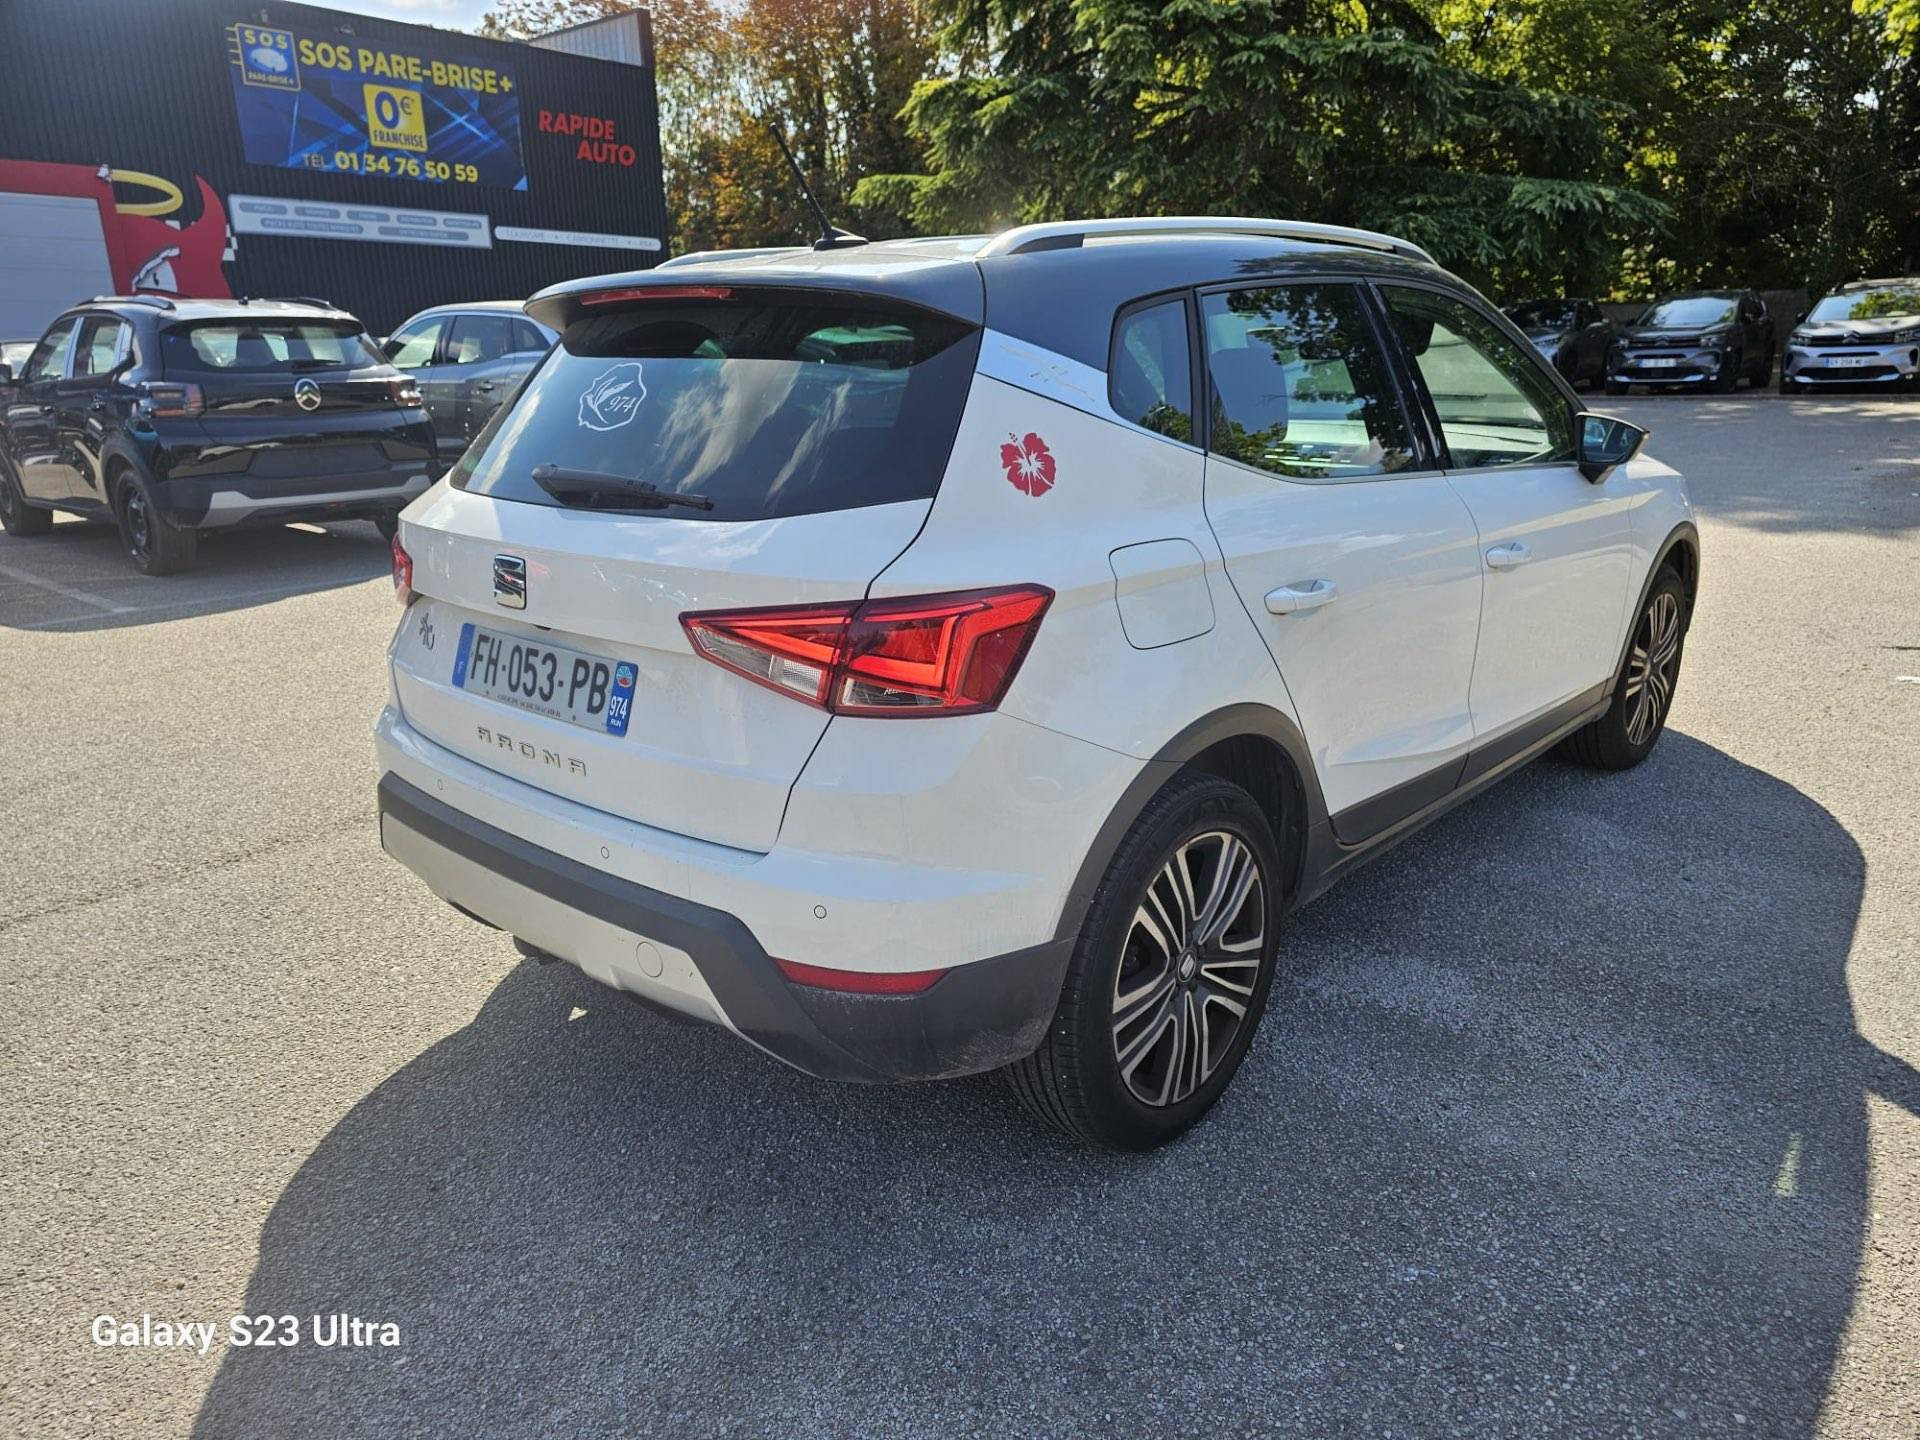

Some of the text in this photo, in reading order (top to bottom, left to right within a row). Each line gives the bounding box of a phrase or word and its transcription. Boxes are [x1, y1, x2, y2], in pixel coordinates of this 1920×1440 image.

[244, 29, 288, 49] SOS
[299, 39, 352, 71] SOS
[373, 129, 424, 148] FRANCHISE
[539, 109, 615, 140] RAPIDE
[335, 151, 359, 171] 01
[364, 154, 391, 174] 34
[395, 157, 420, 177] 76
[424, 161, 450, 180] 50
[454, 163, 478, 183] 59
[576, 140, 636, 167] AUTO
[604, 396, 637, 413] 974
[470, 633, 610, 715] FH-053-PB
[609, 695, 628, 720] 974
[477, 726, 587, 776] ARONA
